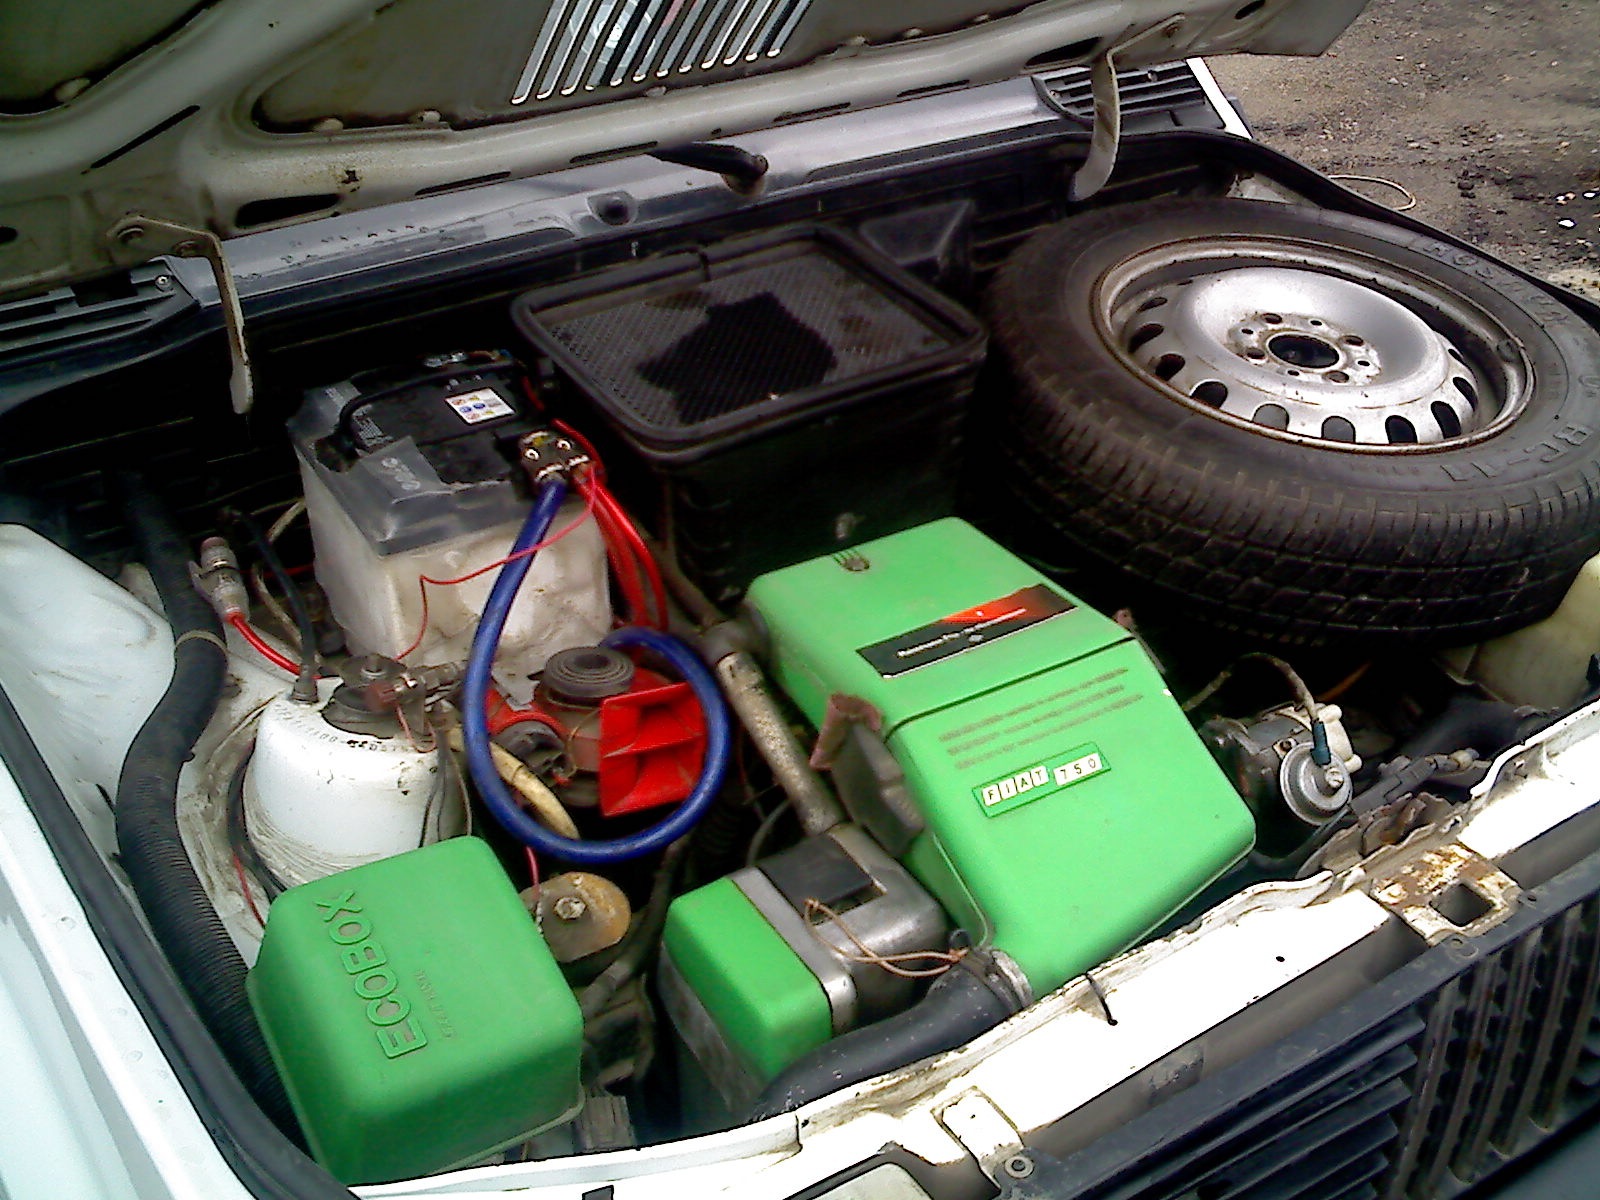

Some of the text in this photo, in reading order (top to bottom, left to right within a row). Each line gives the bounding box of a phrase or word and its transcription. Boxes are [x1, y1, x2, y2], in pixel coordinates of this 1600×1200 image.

[985, 756, 1099, 803] FIAT 750
[315, 888, 429, 1060] ECOBOX
